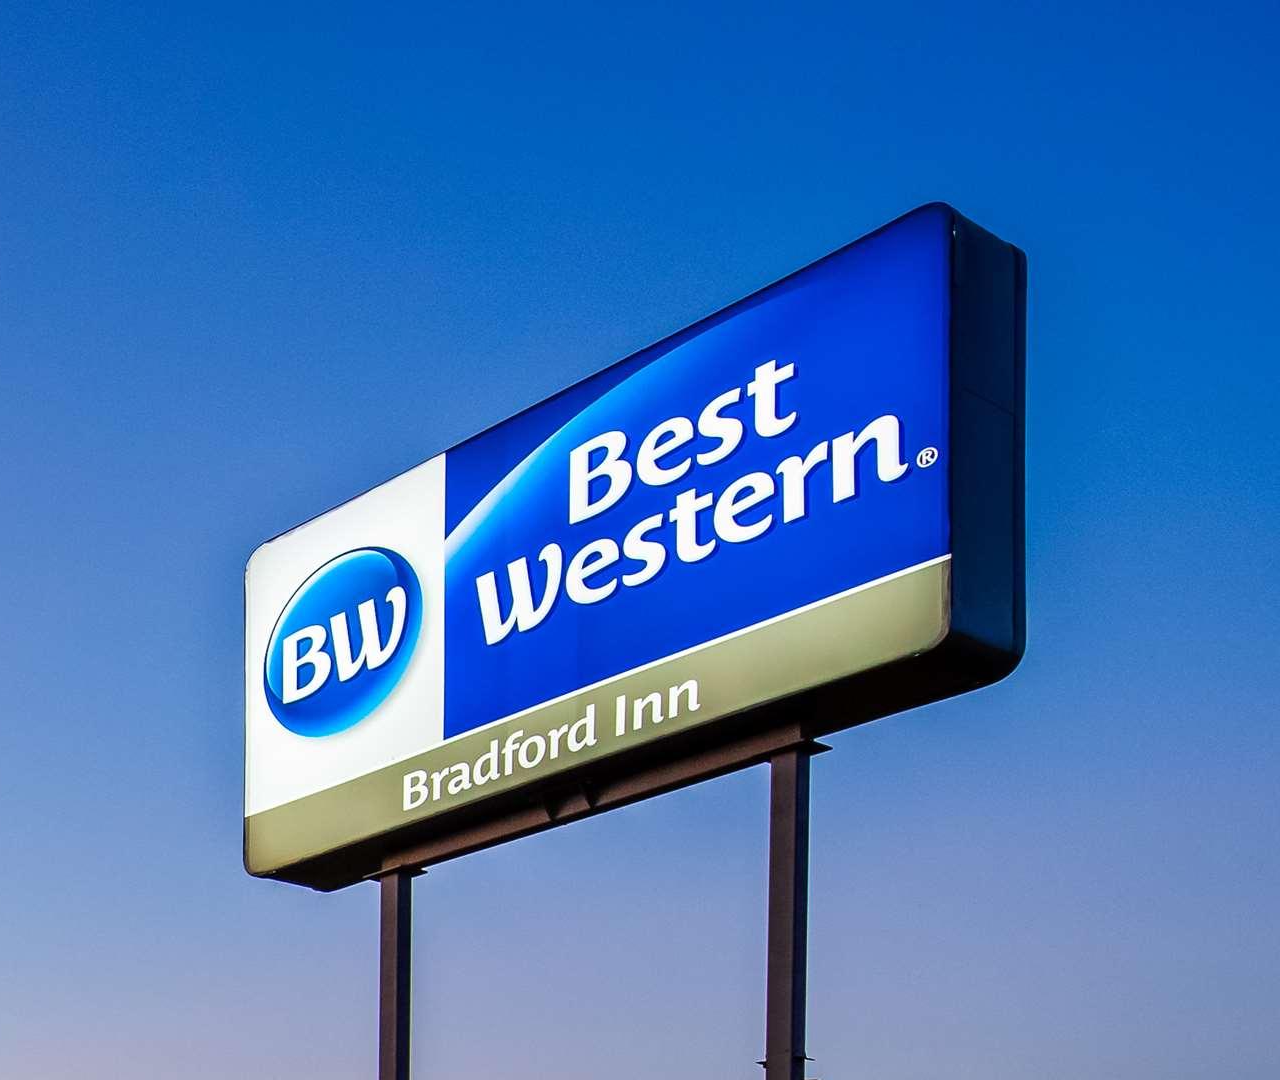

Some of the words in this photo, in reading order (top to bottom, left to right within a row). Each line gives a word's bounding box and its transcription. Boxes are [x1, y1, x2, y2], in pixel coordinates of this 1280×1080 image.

[568, 359, 798, 526] Best
[281, 585, 408, 705] BW
[402, 703, 597, 811] Bradford
[615, 679, 702, 738] Inn
